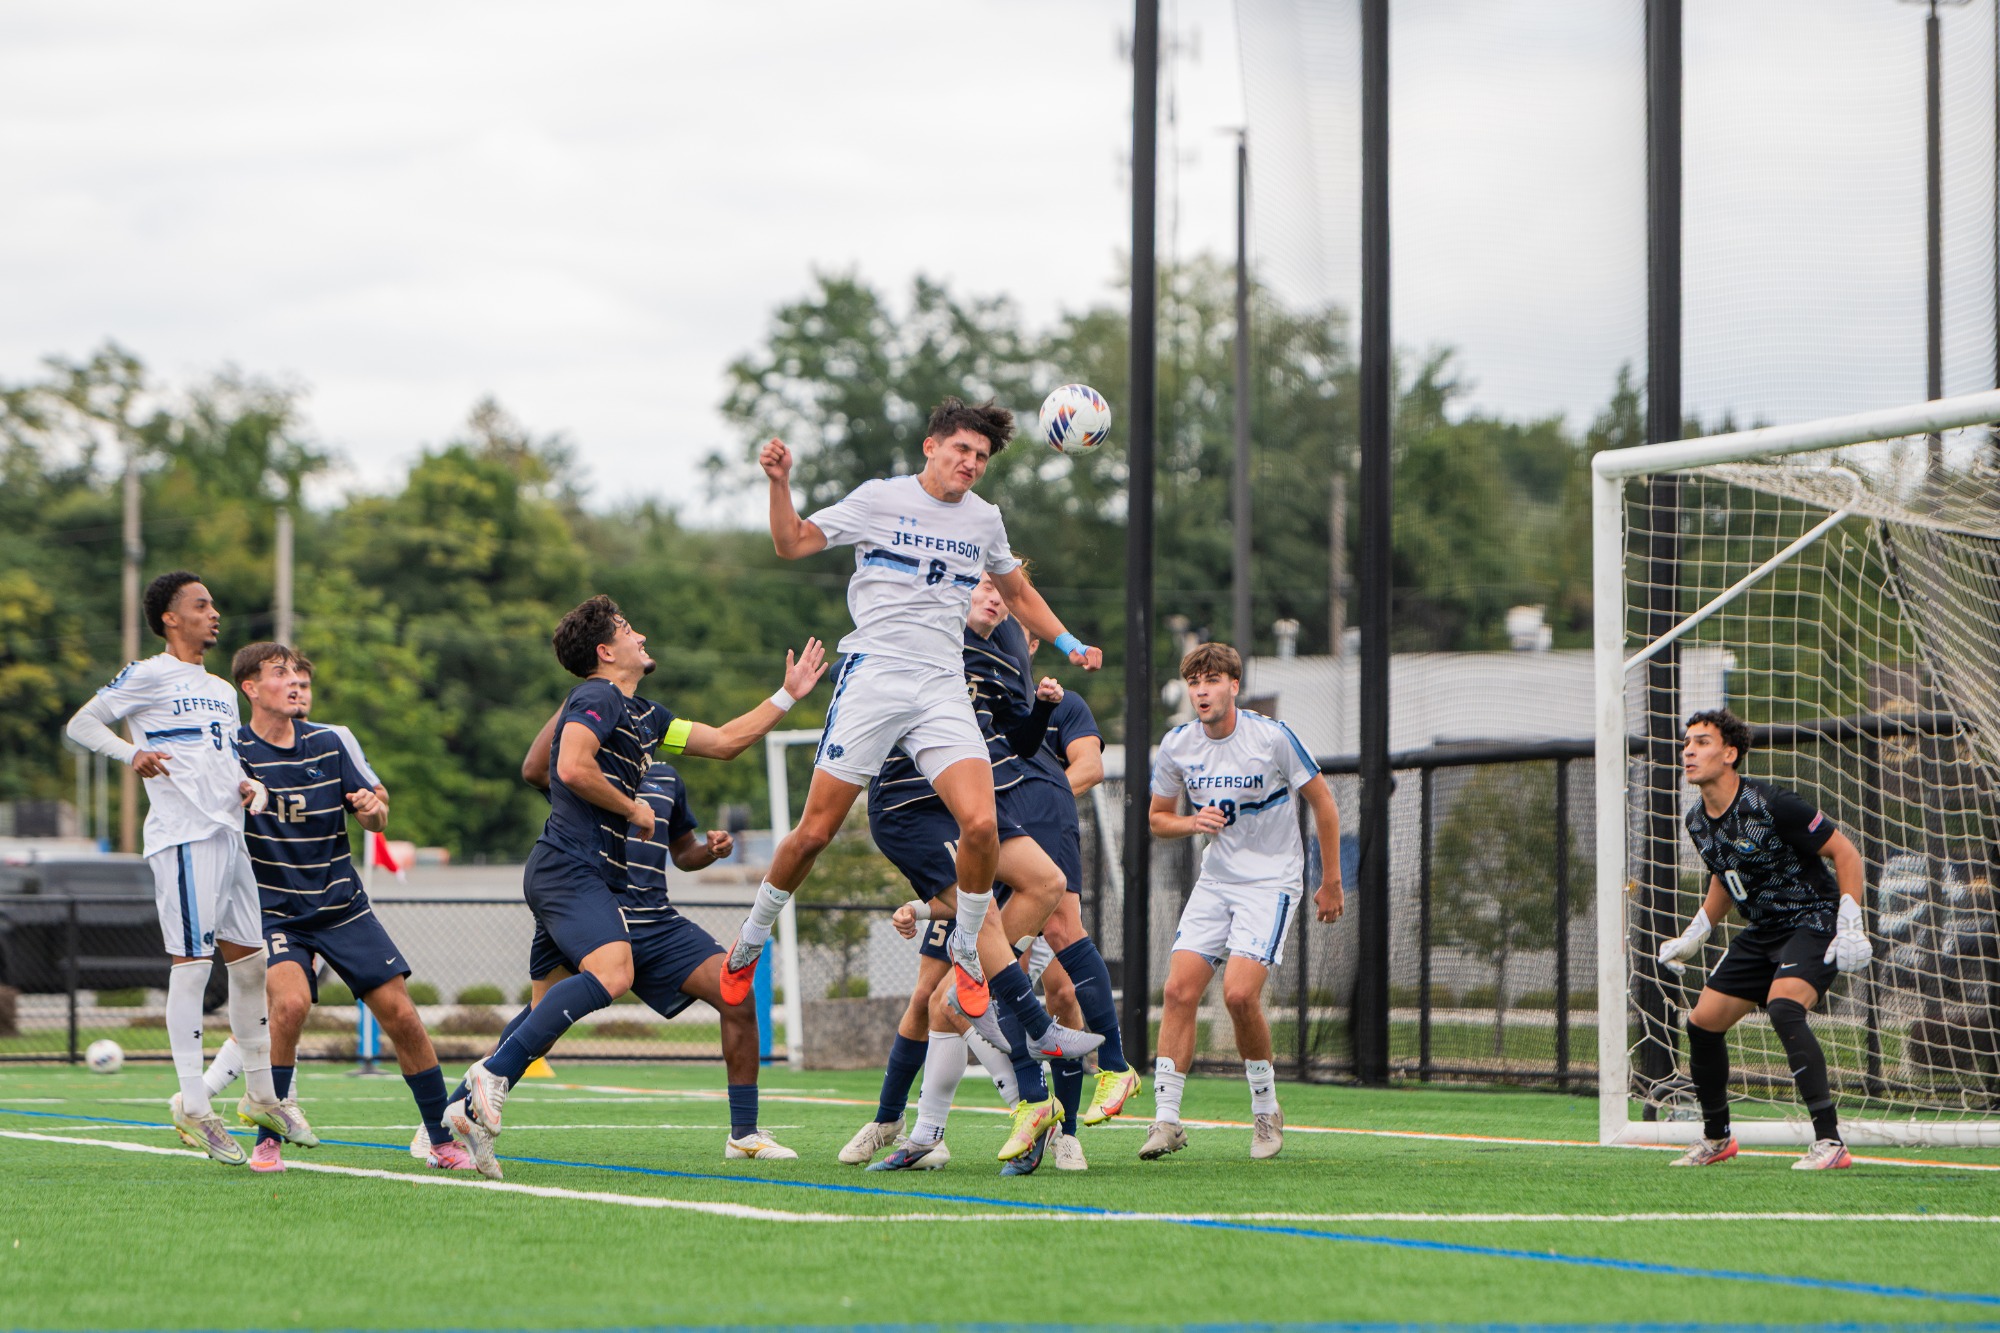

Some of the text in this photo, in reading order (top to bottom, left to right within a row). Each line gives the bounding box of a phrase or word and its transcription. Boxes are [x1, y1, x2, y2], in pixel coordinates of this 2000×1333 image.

[892, 531, 980, 562] JEFFERSON
[926, 559, 947, 586] 6
[210, 721, 222, 751] 9
[276, 793, 307, 823] 12
[1725, 869, 1748, 901] 0
[928, 919, 949, 947] 5
